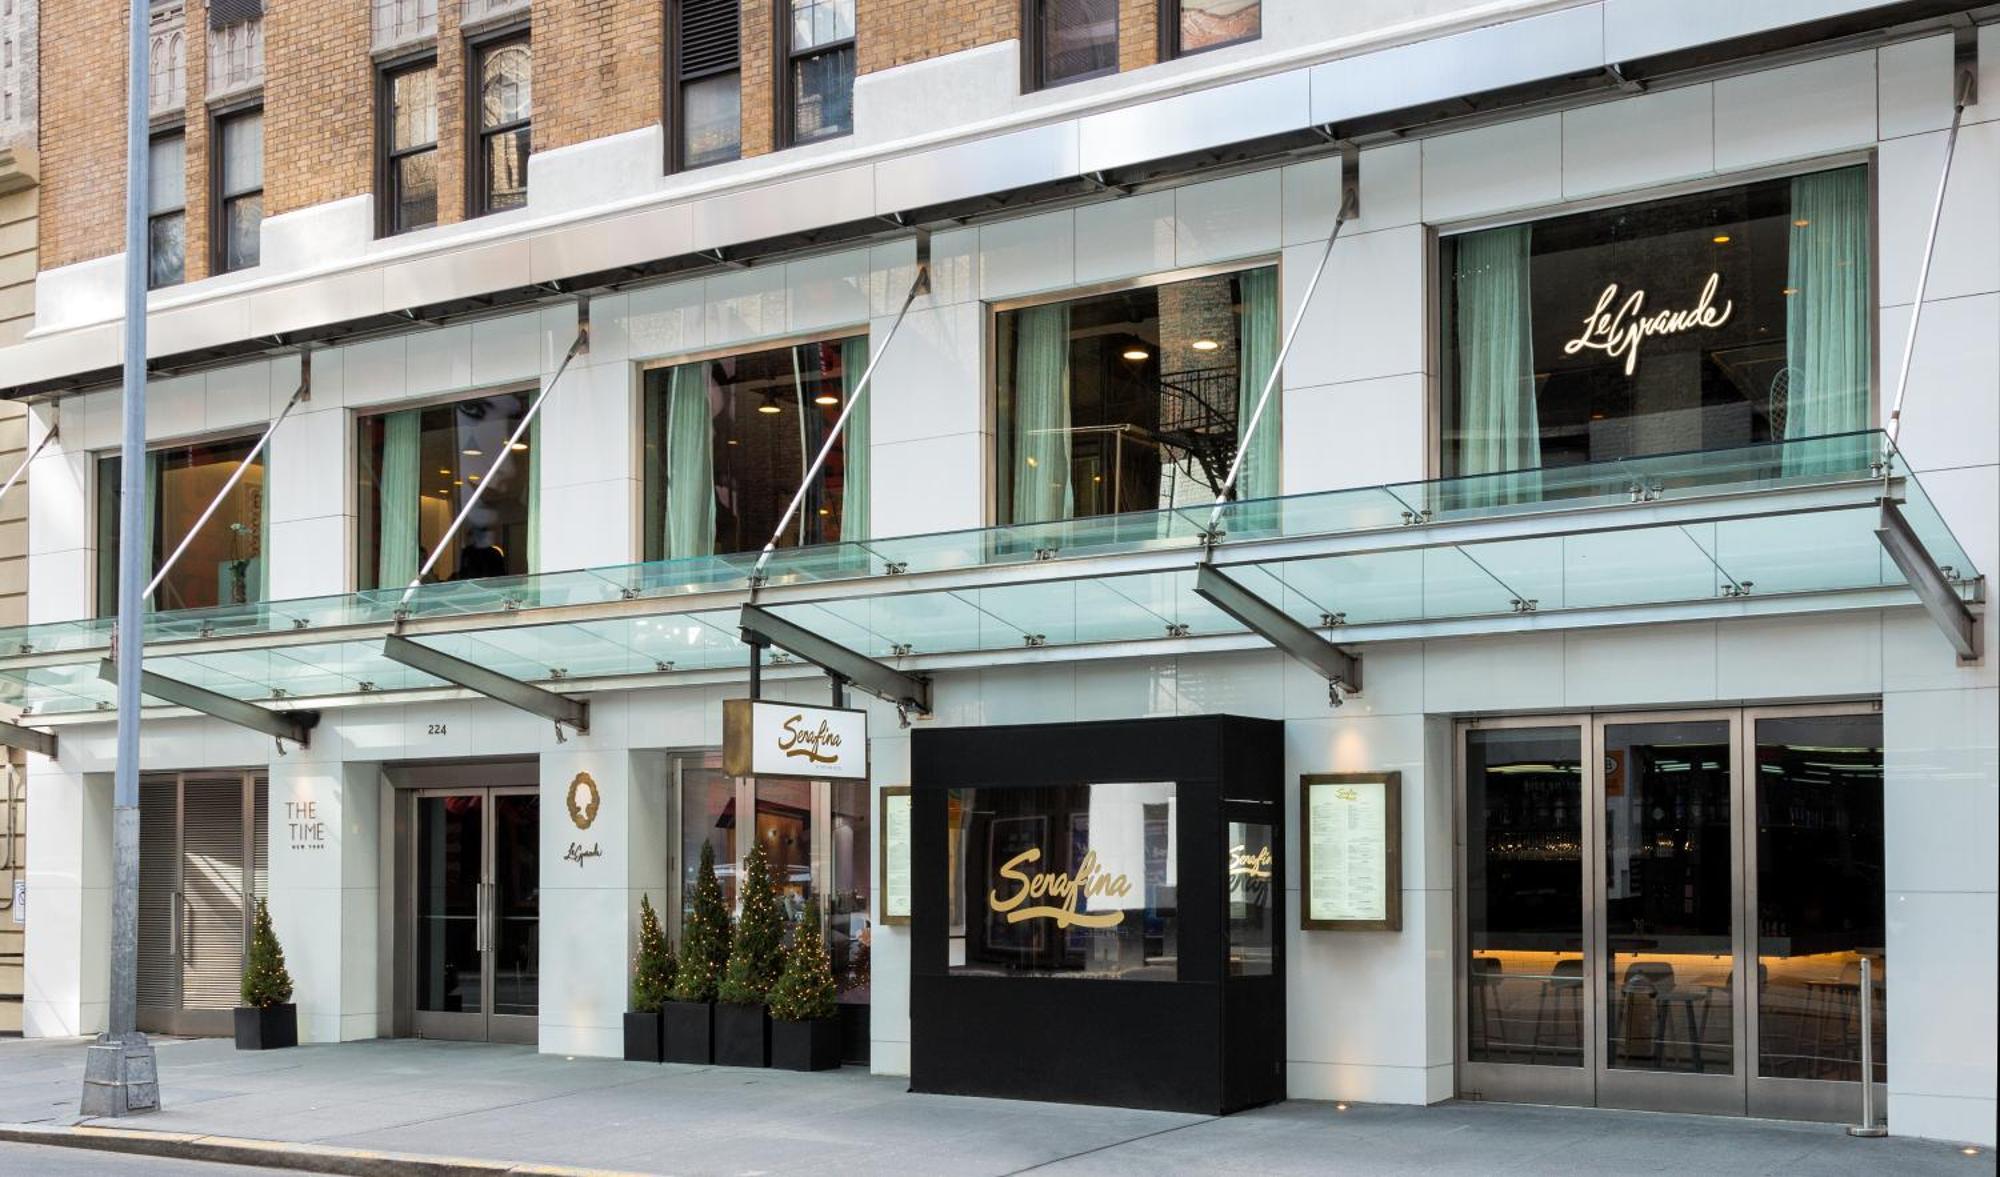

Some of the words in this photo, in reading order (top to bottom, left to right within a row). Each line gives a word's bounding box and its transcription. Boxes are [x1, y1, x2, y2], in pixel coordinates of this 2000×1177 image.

[428, 724, 447, 736] 224
[778, 713, 842, 763] Serafina
[284, 801, 317, 820] THE
[288, 822, 325, 841] TIME
[990, 847, 1132, 929] Serafina
